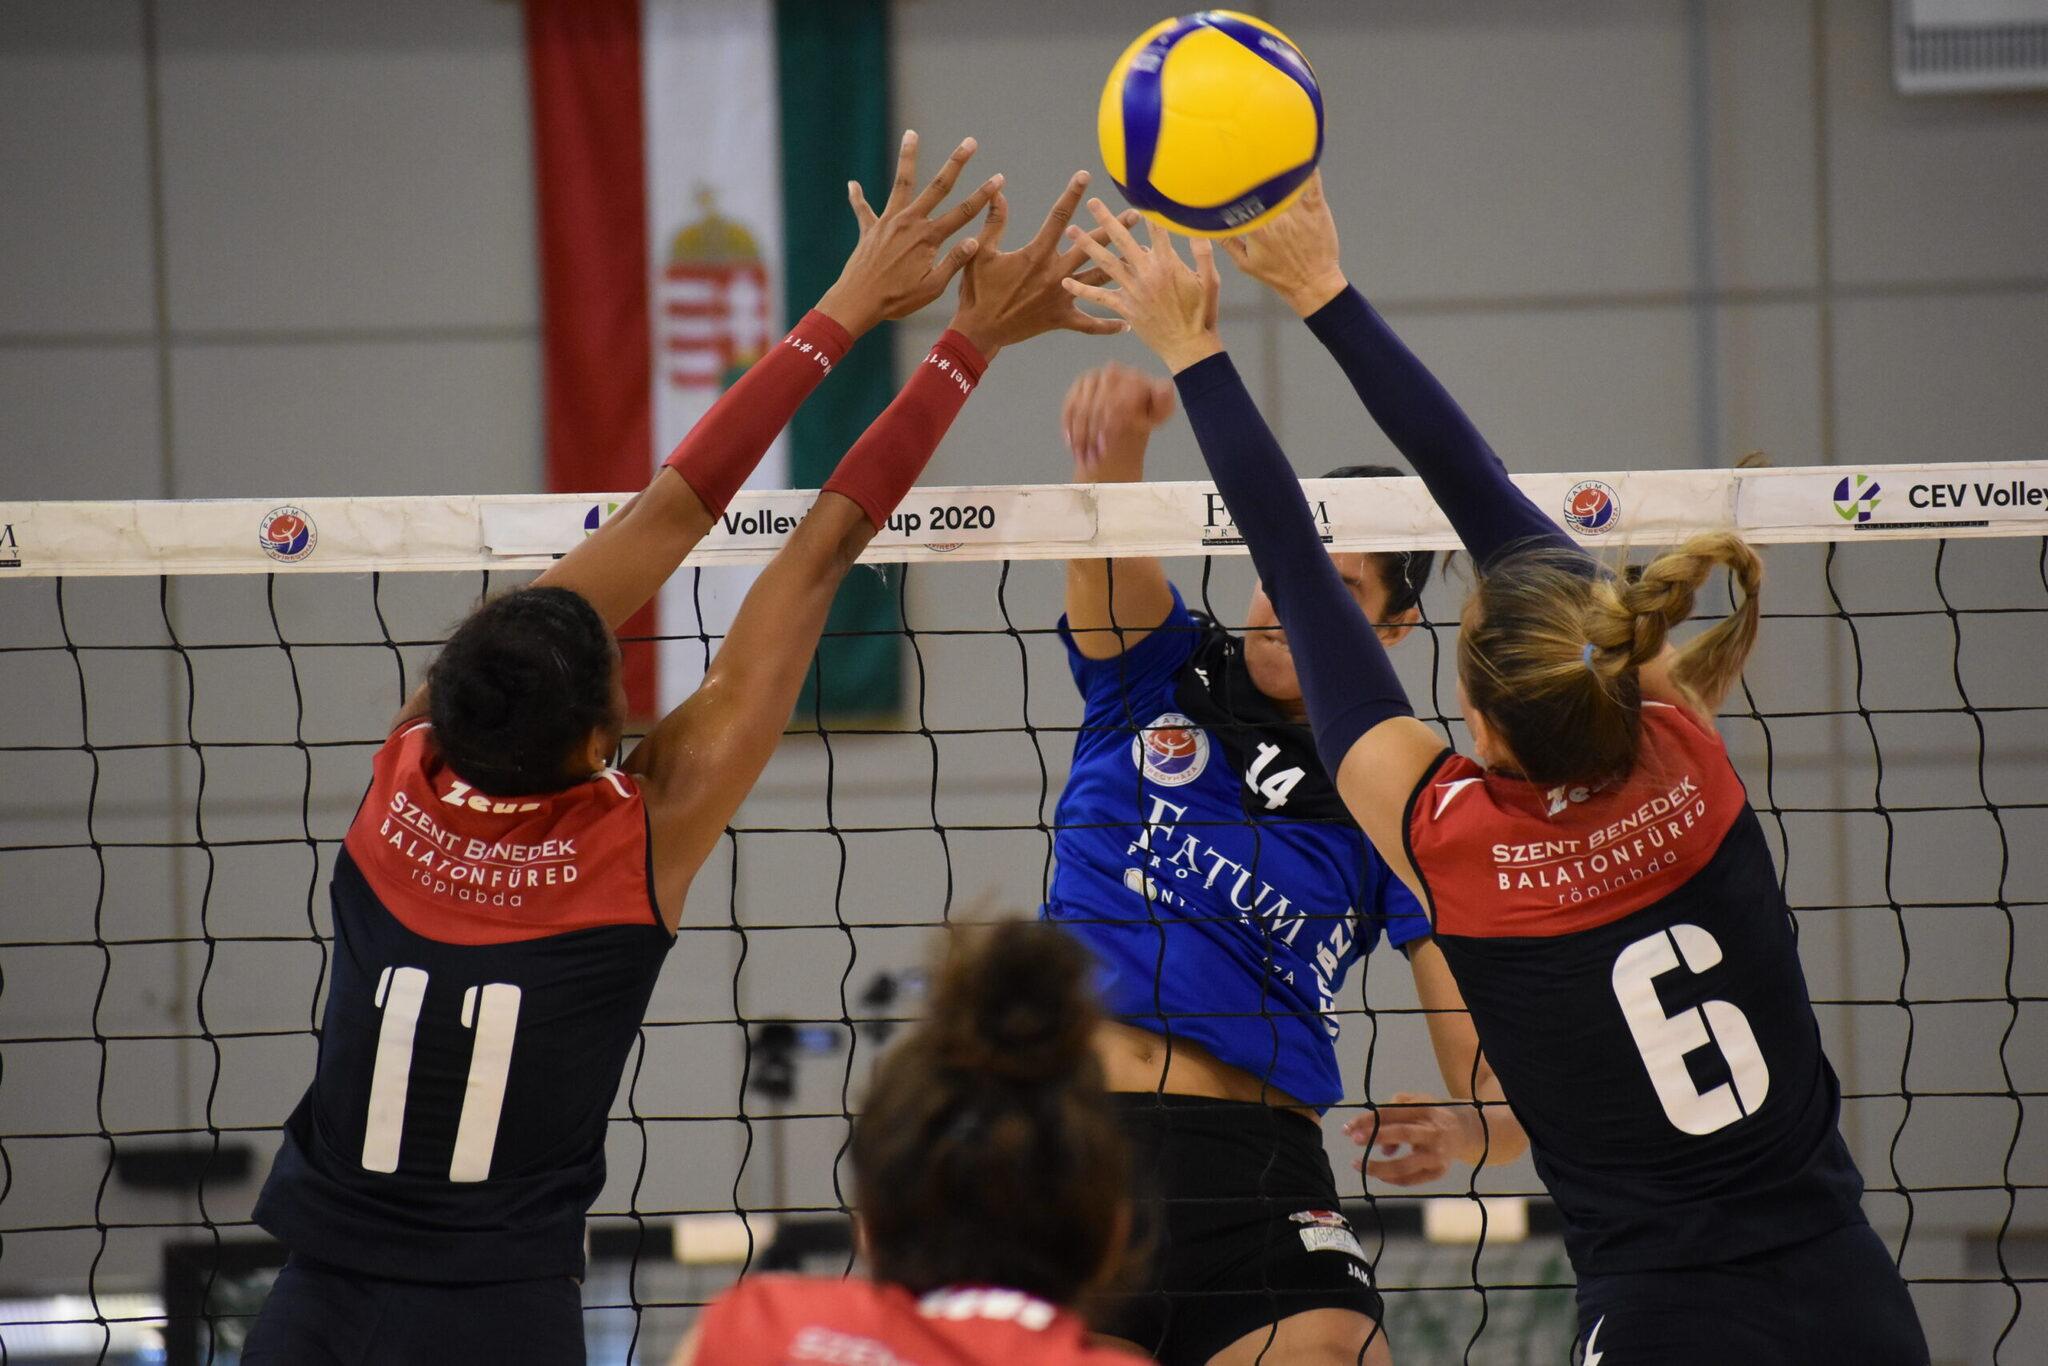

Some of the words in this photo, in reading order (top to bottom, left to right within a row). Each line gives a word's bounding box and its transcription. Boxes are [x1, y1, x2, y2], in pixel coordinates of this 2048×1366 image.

[784, 334, 813, 353] #11
[950, 368, 971, 394] Nel
[263, 509, 299, 530] FATUM
[722, 509, 811, 536] Volle
[878, 513, 922, 537] up
[929, 505, 996, 530] 2020
[1567, 483, 1603, 503] FATUM
[1908, 483, 1967, 508] CEV
[1246, 741, 1306, 810] 14
[390, 791, 460, 851] SZENT
[1492, 839, 1581, 863] SZENT
[1589, 775, 1698, 851] BENEDEK
[1498, 800, 1706, 891] BALATONFÜRED
[379, 818, 578, 889] BALATONFÜRED
[1132, 793, 1308, 948] FATUM
[411, 867, 523, 907] röplabda
[1611, 923, 1770, 1136] 6
[361, 966, 522, 1183] 11
